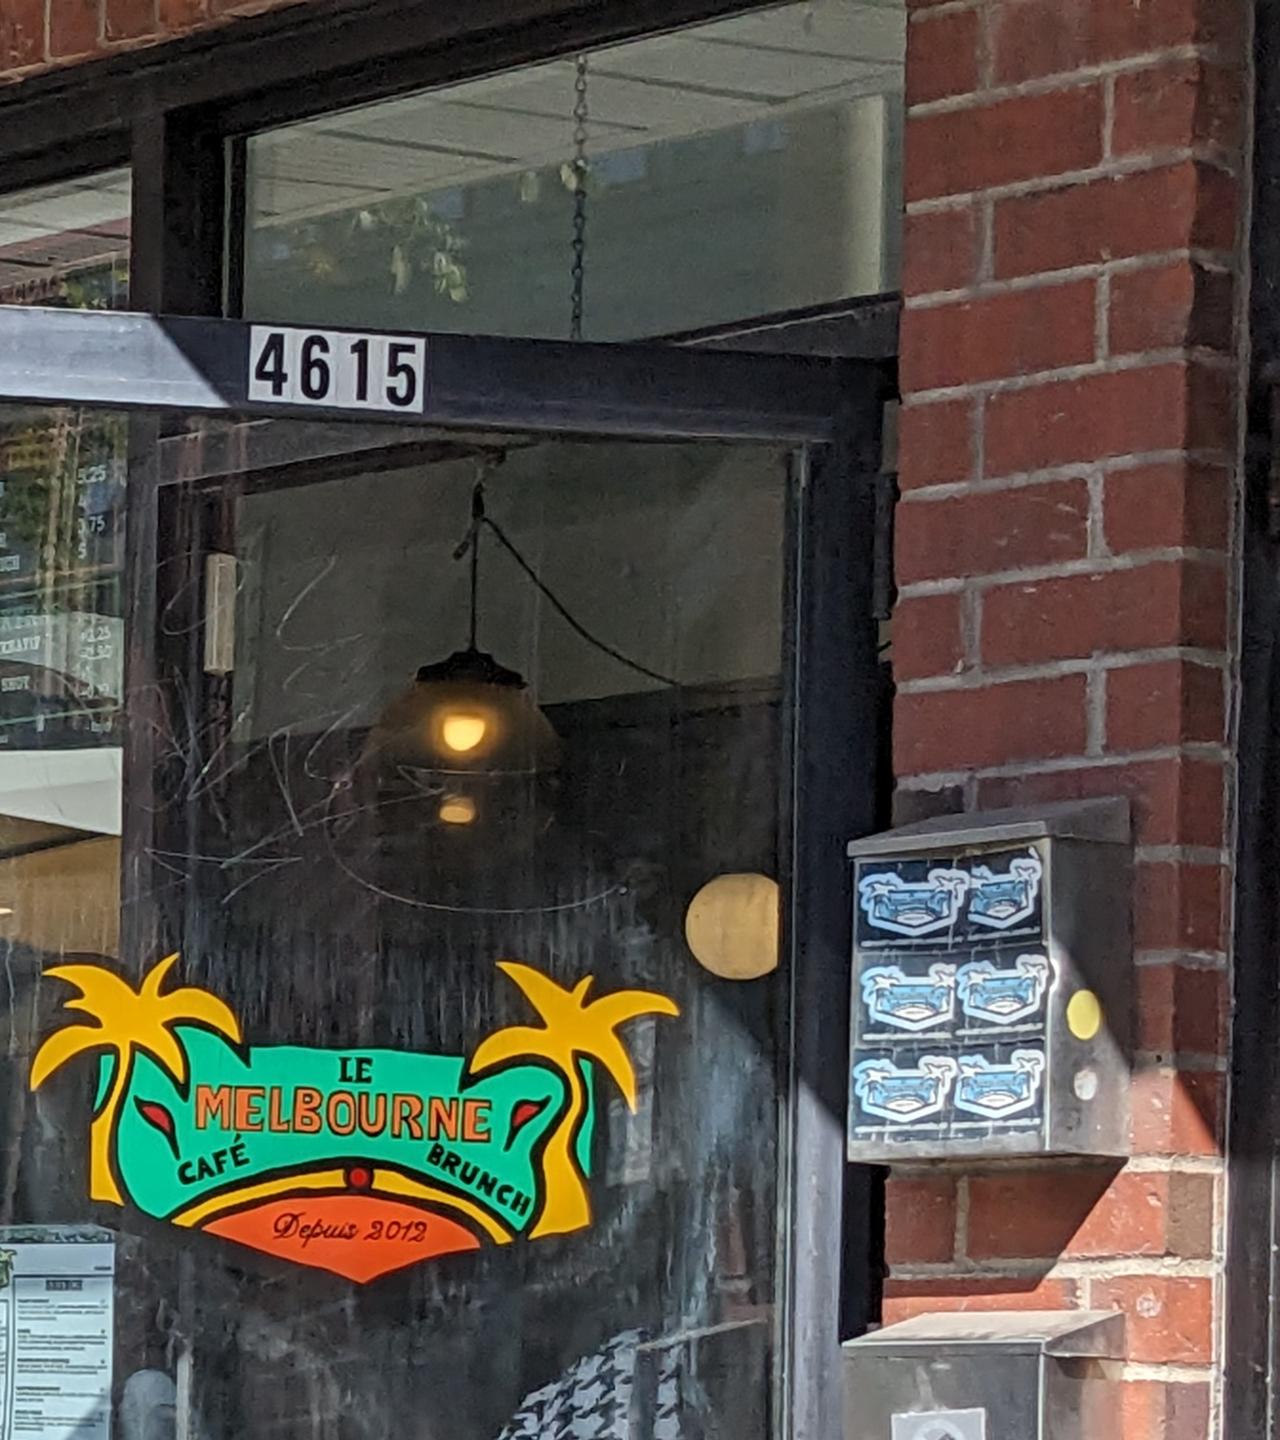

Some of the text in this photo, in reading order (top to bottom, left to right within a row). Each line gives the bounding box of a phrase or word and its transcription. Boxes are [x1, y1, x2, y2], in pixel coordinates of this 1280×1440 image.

[255, 333, 416, 407] 4615
[338, 1056, 372, 1083] LE
[195, 1083, 492, 1142] MELBOURNE
[177, 1134, 250, 1186] CAFÉ
[426, 1142, 532, 1217] BRUNCH
[273, 1211, 428, 1247] Depuis 2012
